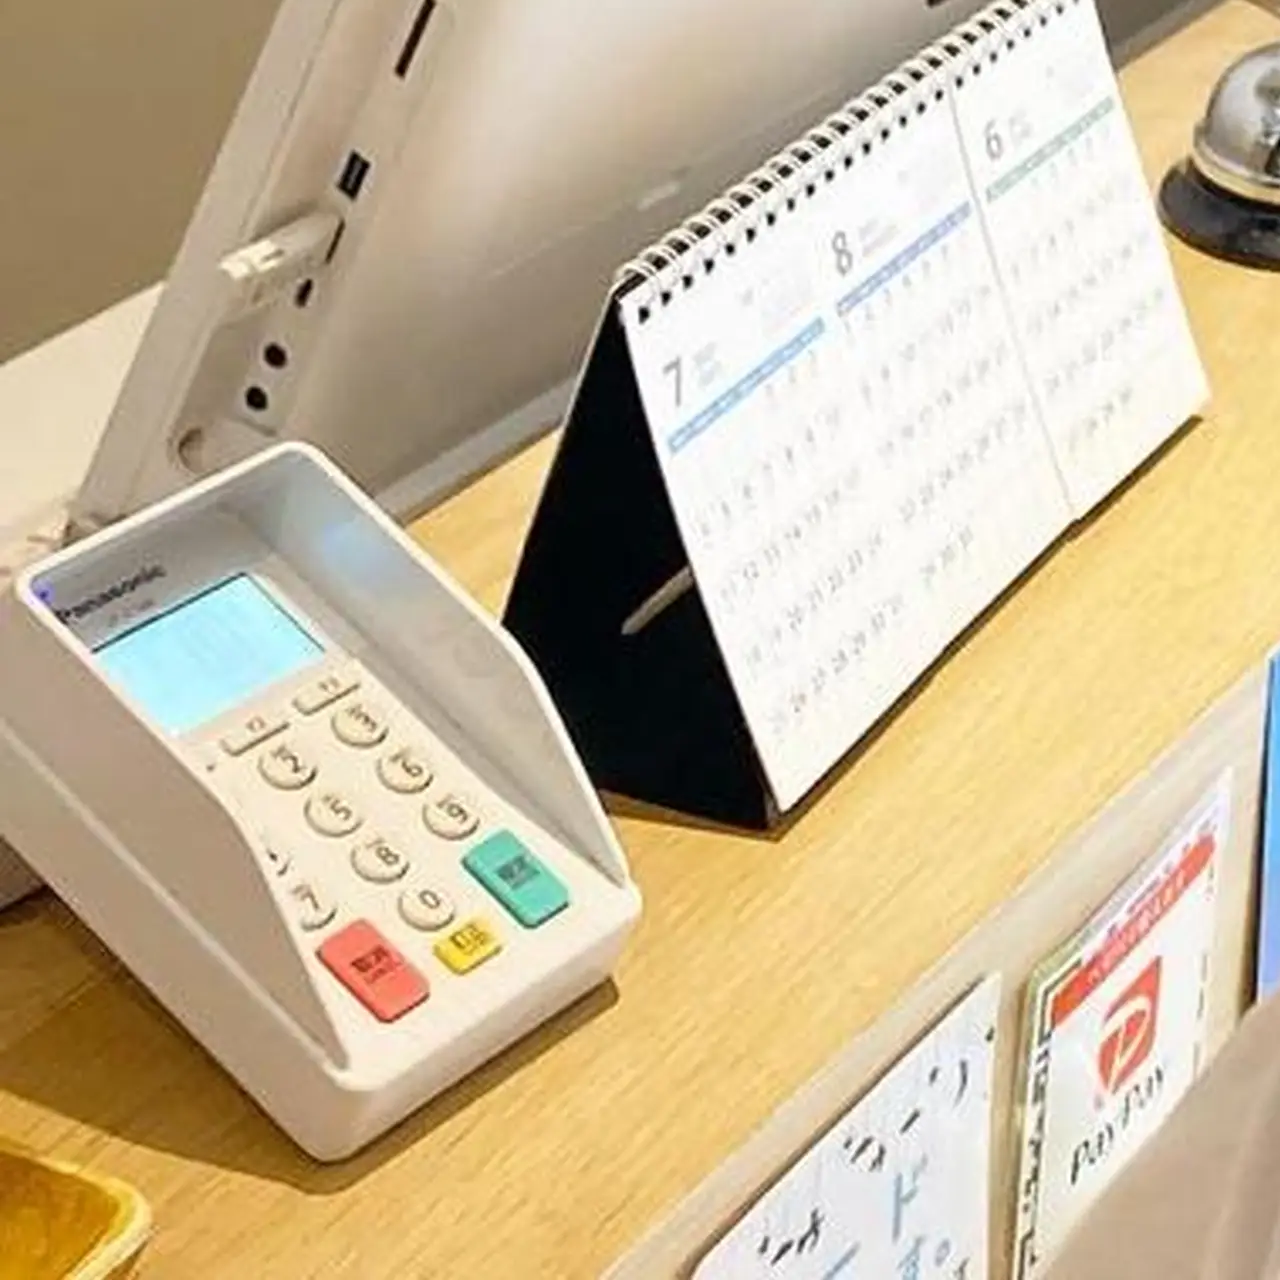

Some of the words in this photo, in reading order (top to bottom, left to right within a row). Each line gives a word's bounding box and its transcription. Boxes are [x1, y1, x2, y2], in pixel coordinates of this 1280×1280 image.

[984, 118, 1003, 161] 6
[831, 229, 854, 277] 8
[661, 354, 683, 407] 7
[1069, 1065, 1164, 1186] PayPay
